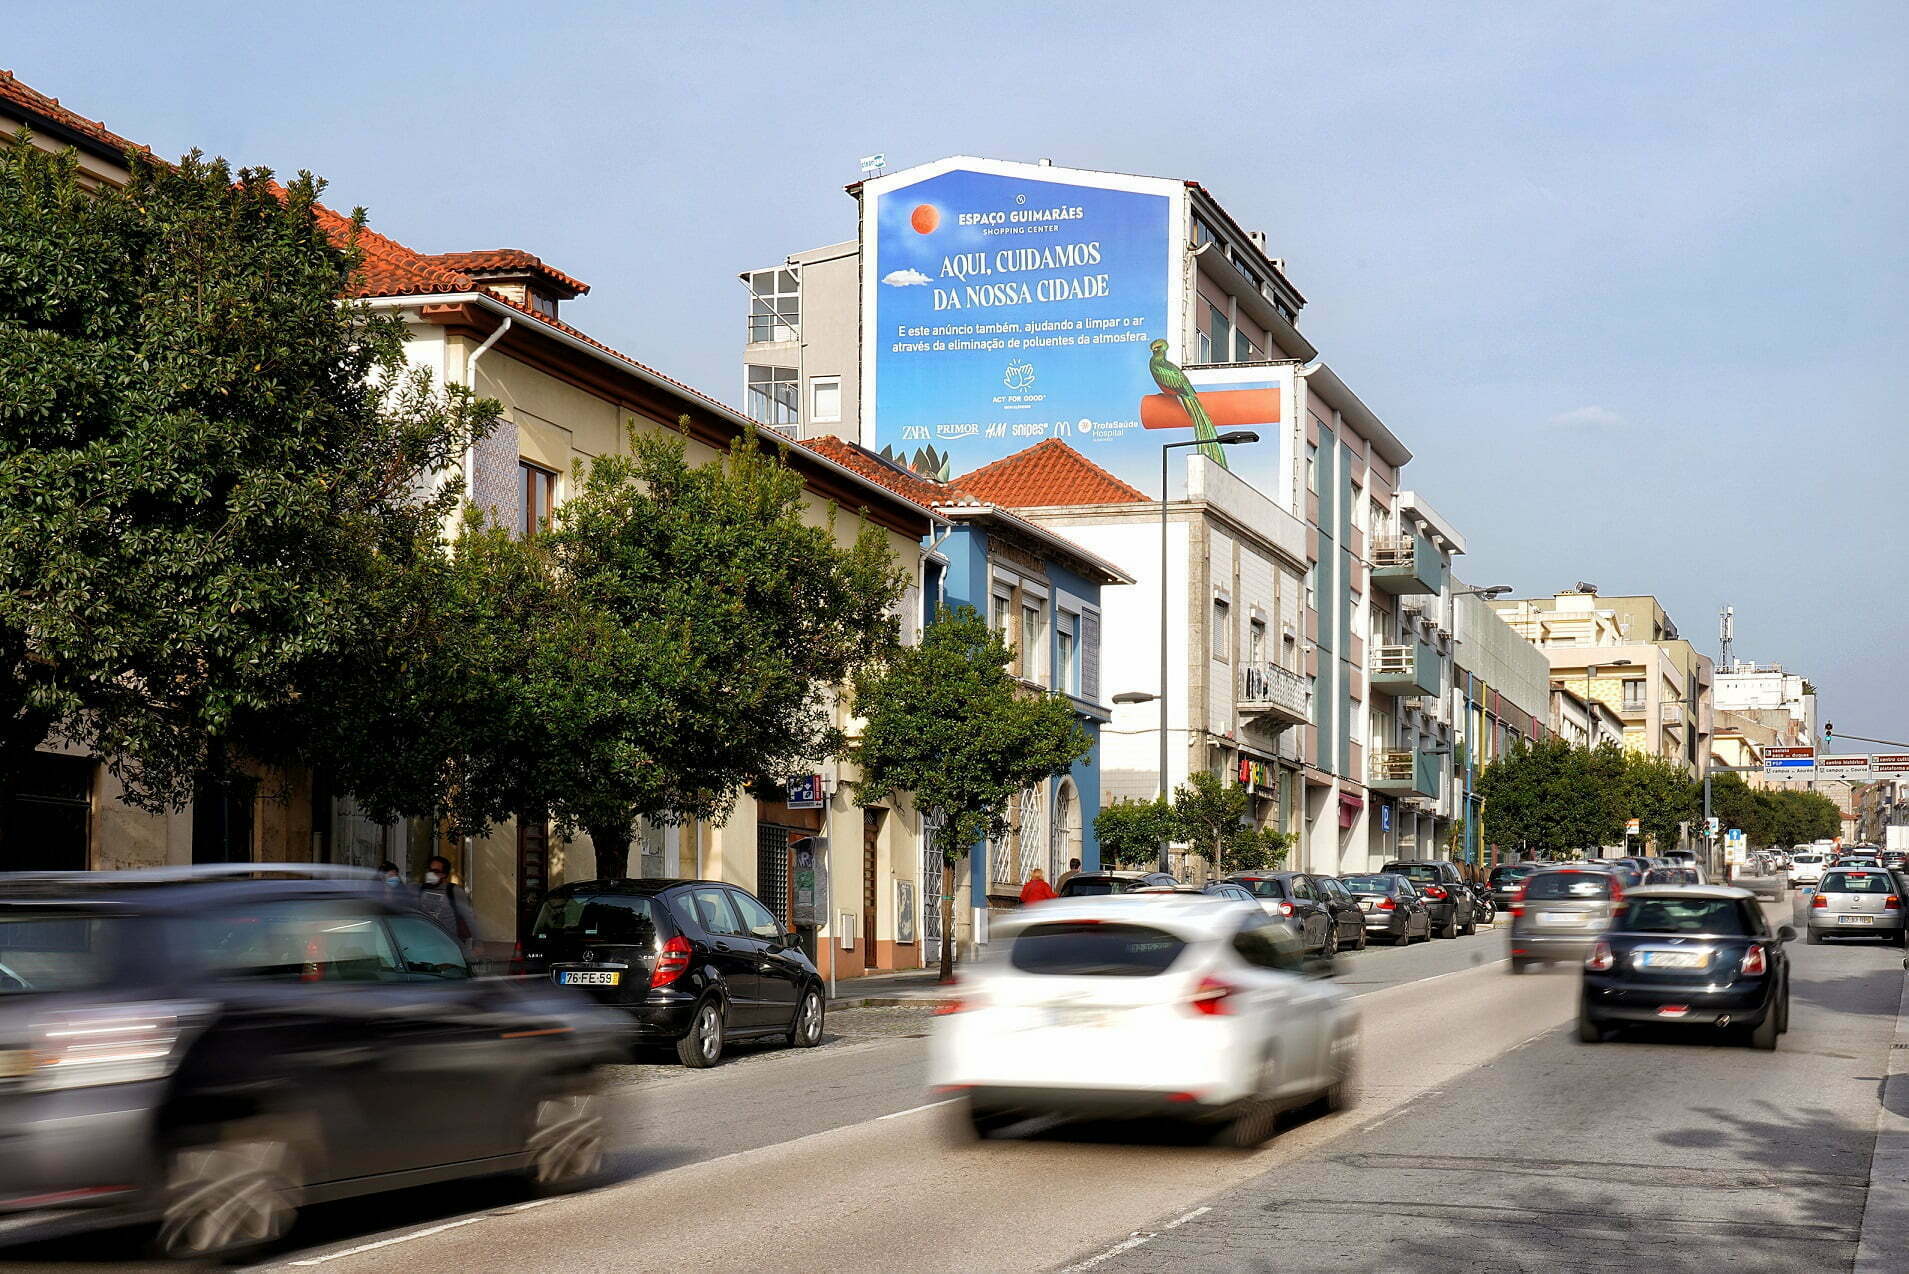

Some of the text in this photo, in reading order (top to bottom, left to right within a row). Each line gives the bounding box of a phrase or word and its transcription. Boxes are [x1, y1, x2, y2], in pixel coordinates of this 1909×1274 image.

[958, 205, 1084, 226] ESPAÇO GUIMARÃES
[983, 224, 1059, 236] SHOPPING CENTER
[939, 241, 1101, 282] AQUI, CUIDAMOS
[933, 273, 1110, 311] DA NOSSA CIDADE
[898, 325, 906, 337] E
[908, 325, 930, 337] este
[932, 323, 973, 336] anúncio
[1024, 319, 1074, 334] ajudando
[1075, 320, 1083, 329] a
[1085, 317, 1120, 331] limpar
[1123, 318, 1130, 326] o
[1132, 316, 1145, 326] ar
[892, 341, 930, 353] através
[933, 340, 946, 352] da
[948, 337, 1005, 351] eliminação
[1007, 337, 1021, 349] de
[1023, 334, 1075, 350] poluentes
[1077, 333, 1091, 345] da
[1008, 395, 1021, 403] FOR
[902, 425, 931, 440] ZARA
[936, 423, 979, 434] PRIMOR
[985, 422, 1008, 439] H&M
[1092, 429, 1124, 438] Hospital
